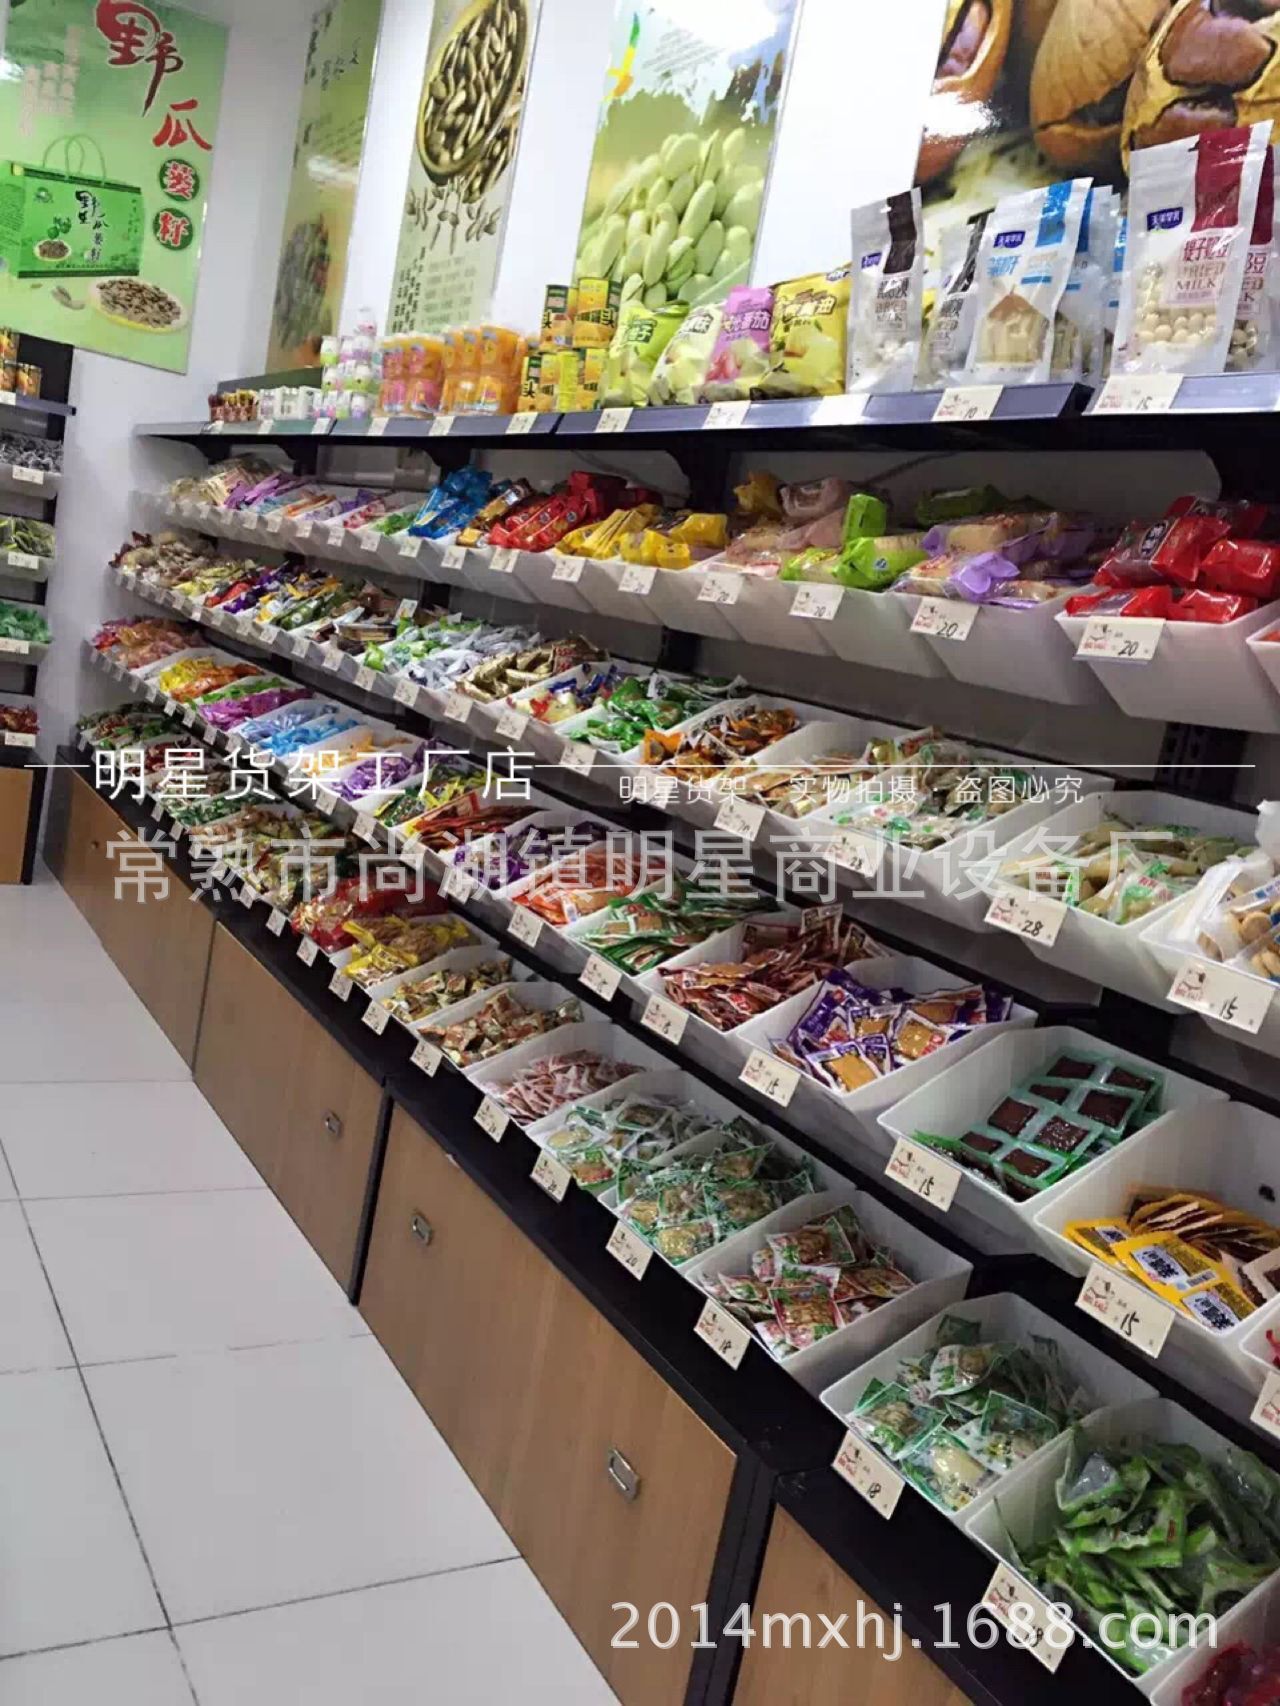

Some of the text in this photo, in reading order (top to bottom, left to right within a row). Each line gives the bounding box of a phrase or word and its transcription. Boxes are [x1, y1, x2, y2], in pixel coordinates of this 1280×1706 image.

[1176, 278, 1216, 291] MILK
[936, 621, 959, 637] 20
[1118, 639, 1139, 656] 20
[1020, 919, 1044, 937] 28
[1218, 995, 1239, 1020] 15
[765, 1077, 780, 1096] 15
[918, 1176, 935, 1196] 15
[1119, 1311, 1140, 1337] 15
